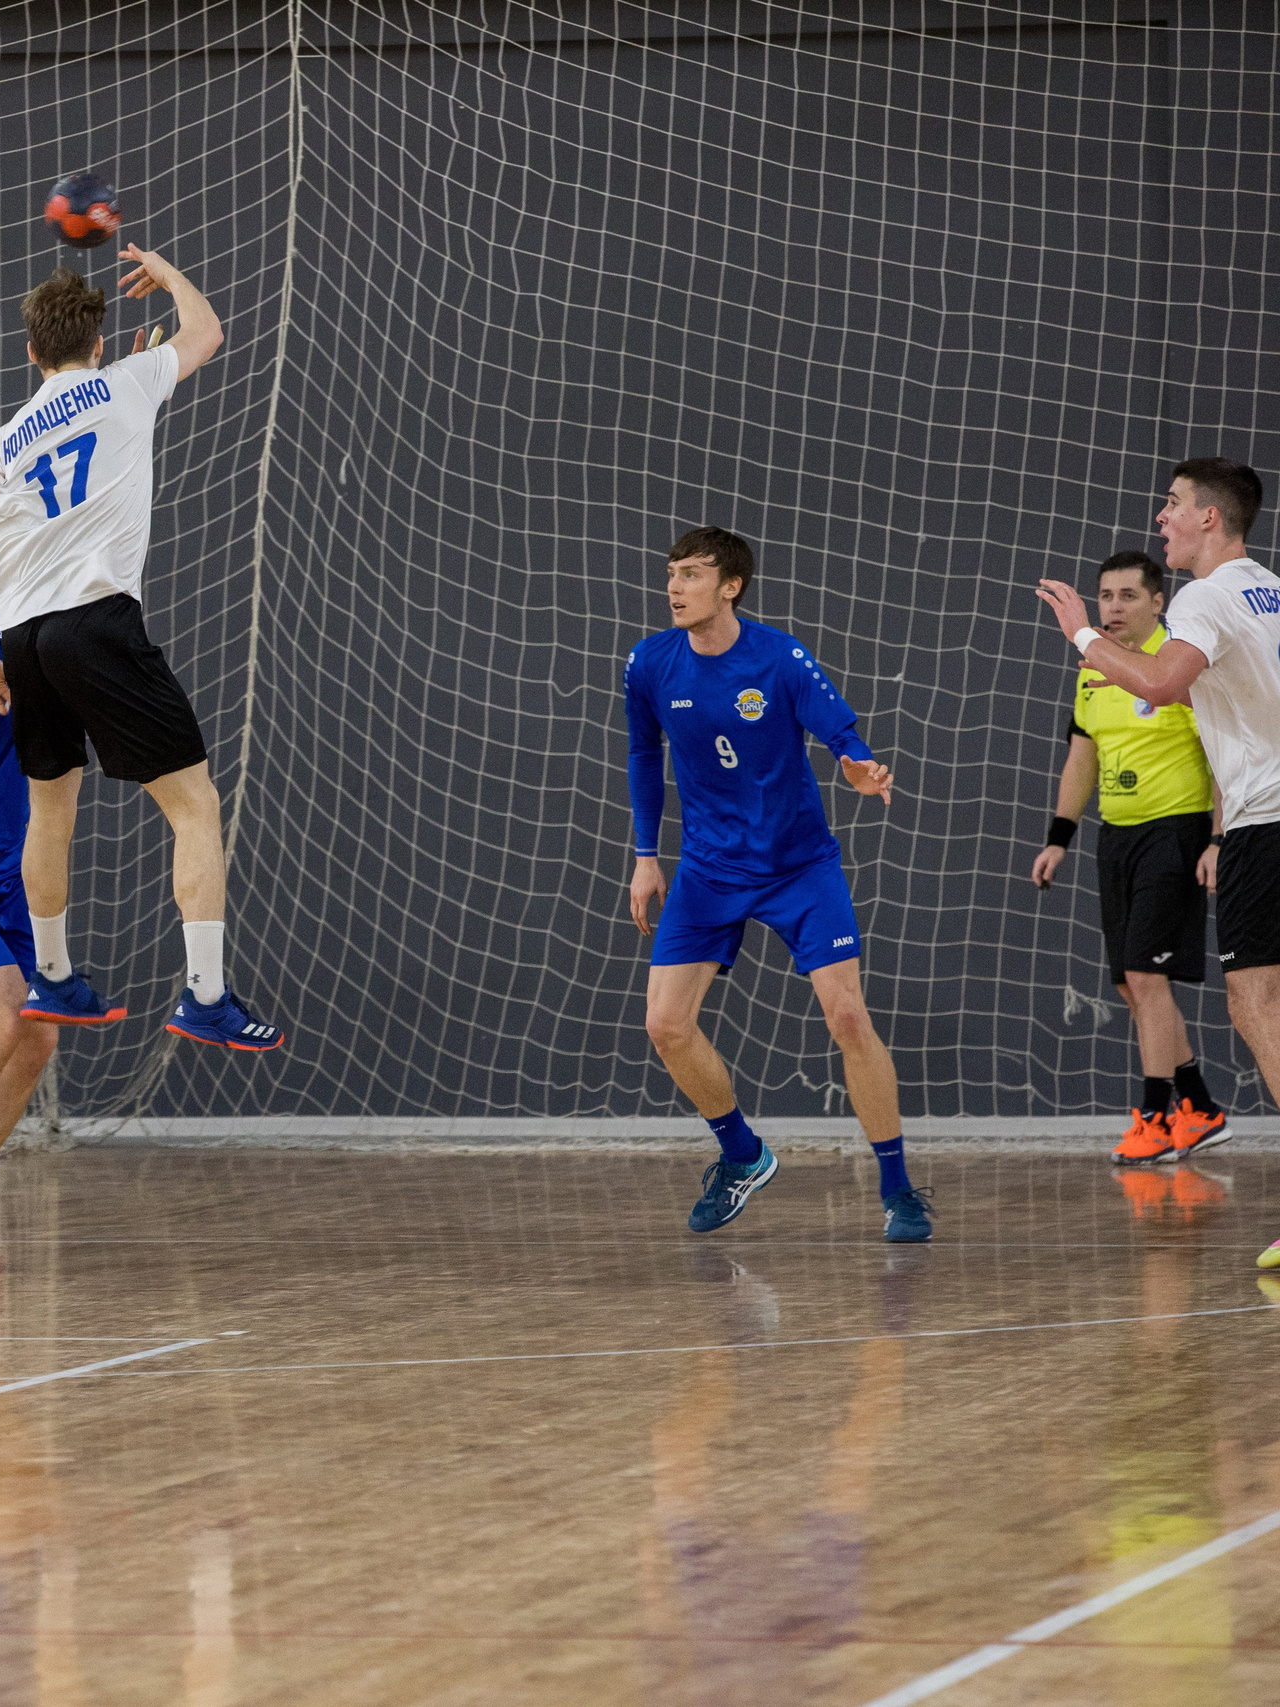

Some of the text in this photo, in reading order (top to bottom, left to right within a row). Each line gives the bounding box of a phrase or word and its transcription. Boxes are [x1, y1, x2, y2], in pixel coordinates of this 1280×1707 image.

[3, 377, 112, 466] КОЛПАЩЕНКО
[24, 431, 98, 519] 17
[1241, 586, 1280, 616] ПОБ
[671, 699, 693, 709] JAKO
[714, 735, 739, 769] 9
[832, 935, 854, 948] JAKO
